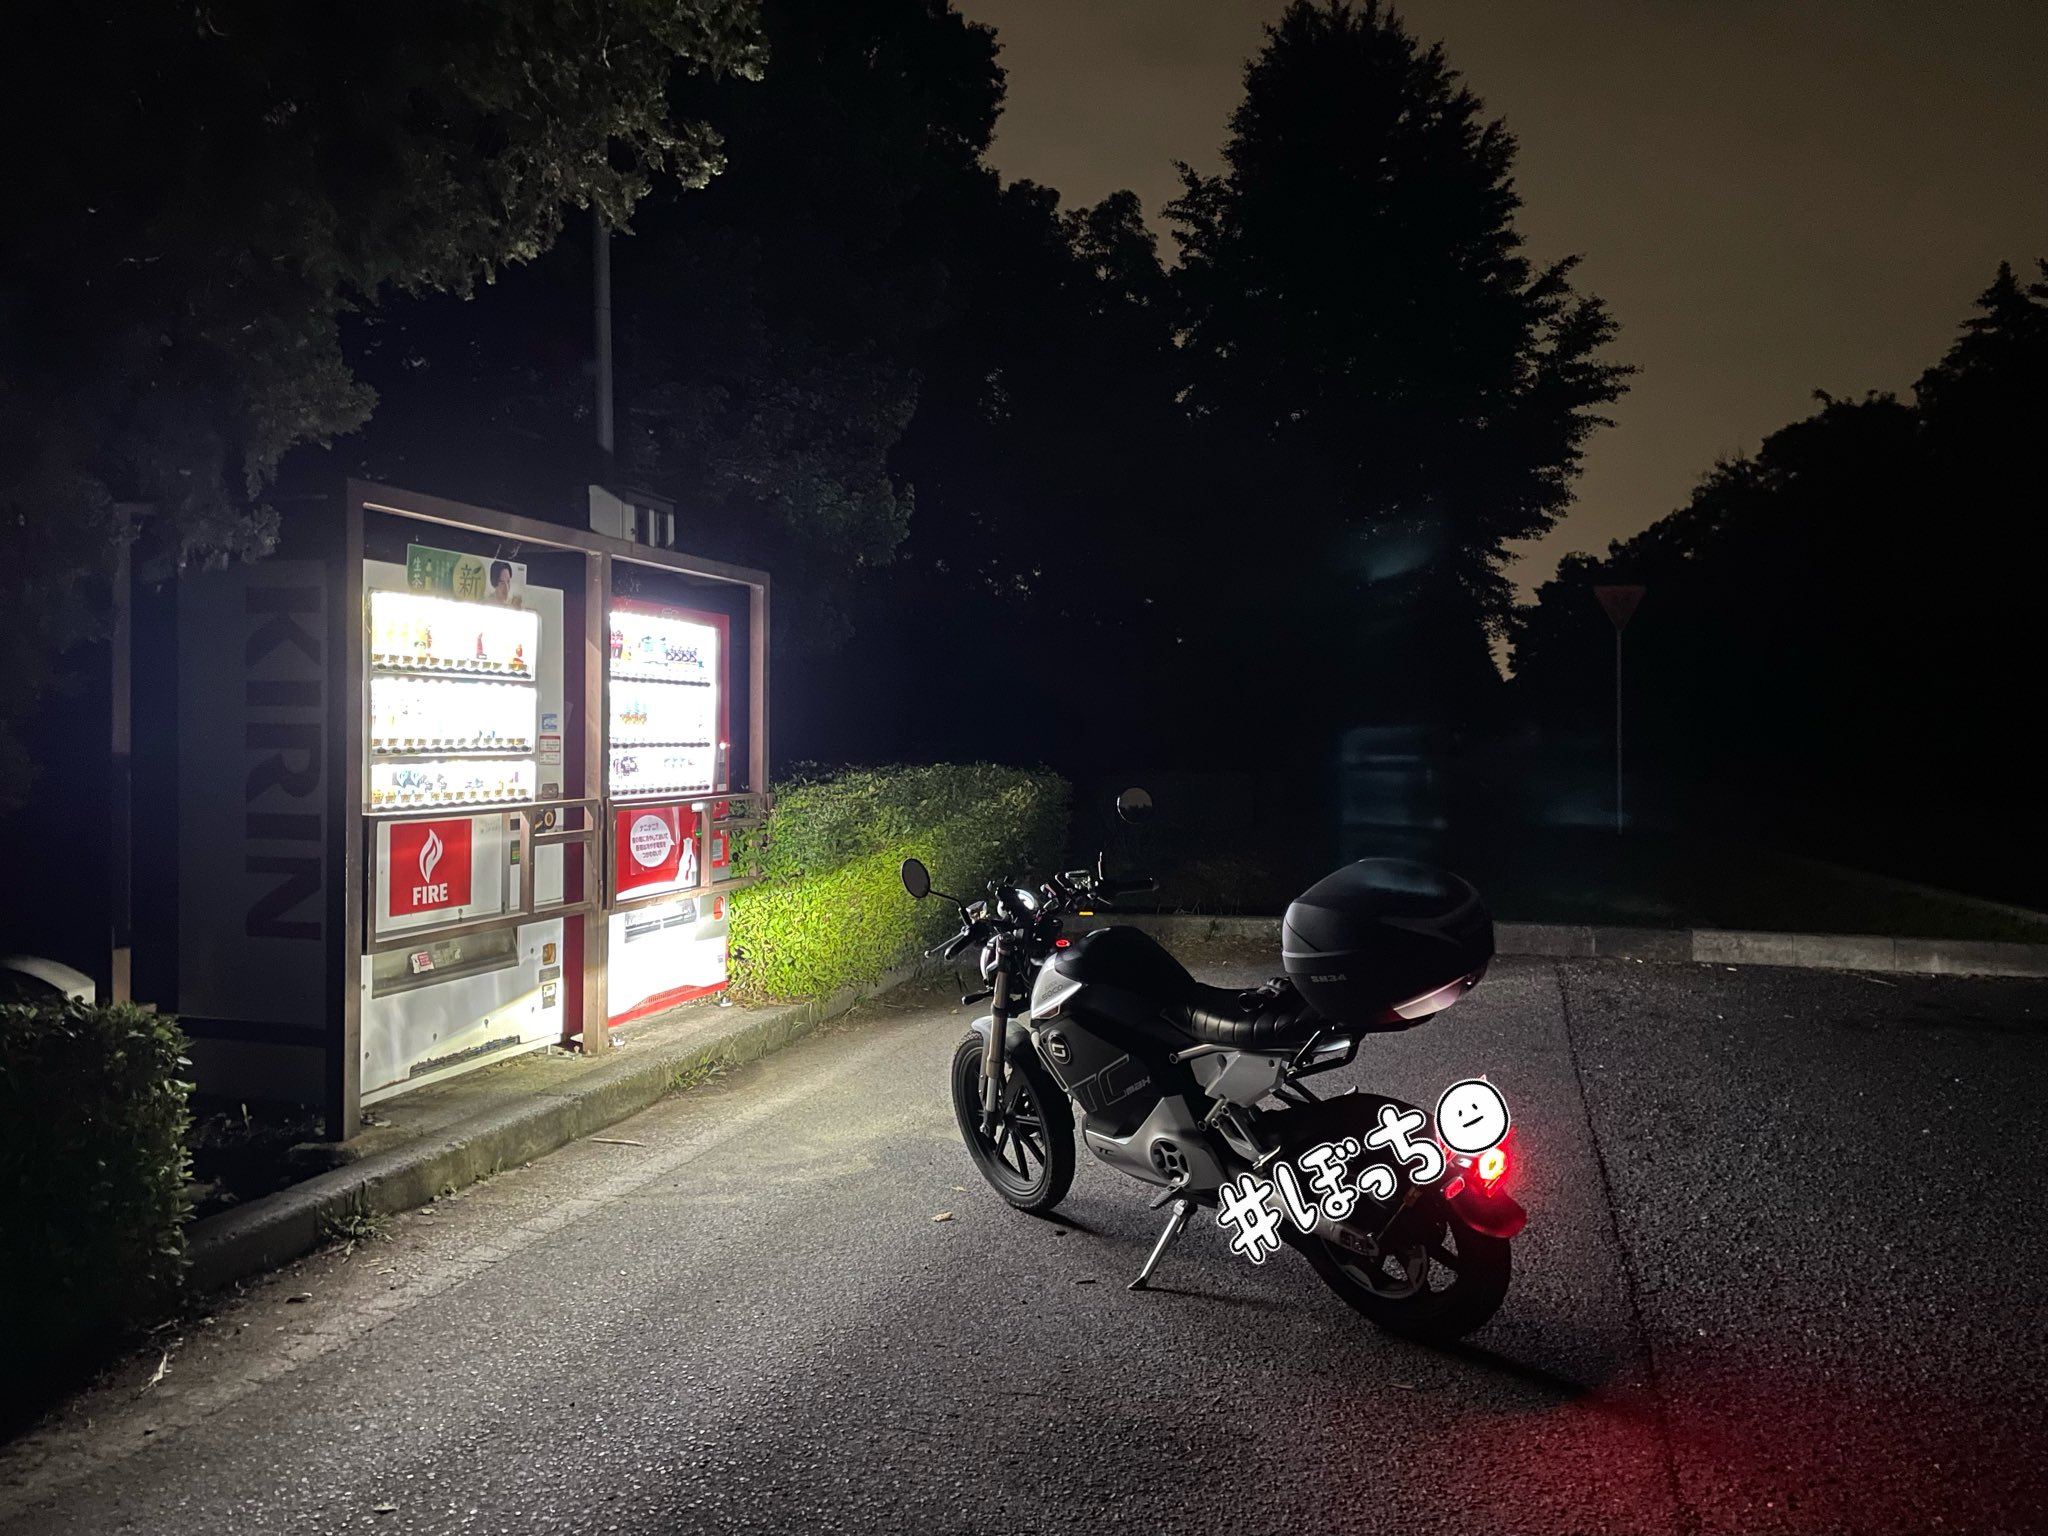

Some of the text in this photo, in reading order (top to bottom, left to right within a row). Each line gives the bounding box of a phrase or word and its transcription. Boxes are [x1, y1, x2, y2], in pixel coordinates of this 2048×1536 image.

[459, 563, 483, 600] 新
[245, 586, 322, 941] KIRIN
[412, 882, 449, 906] FIRE
